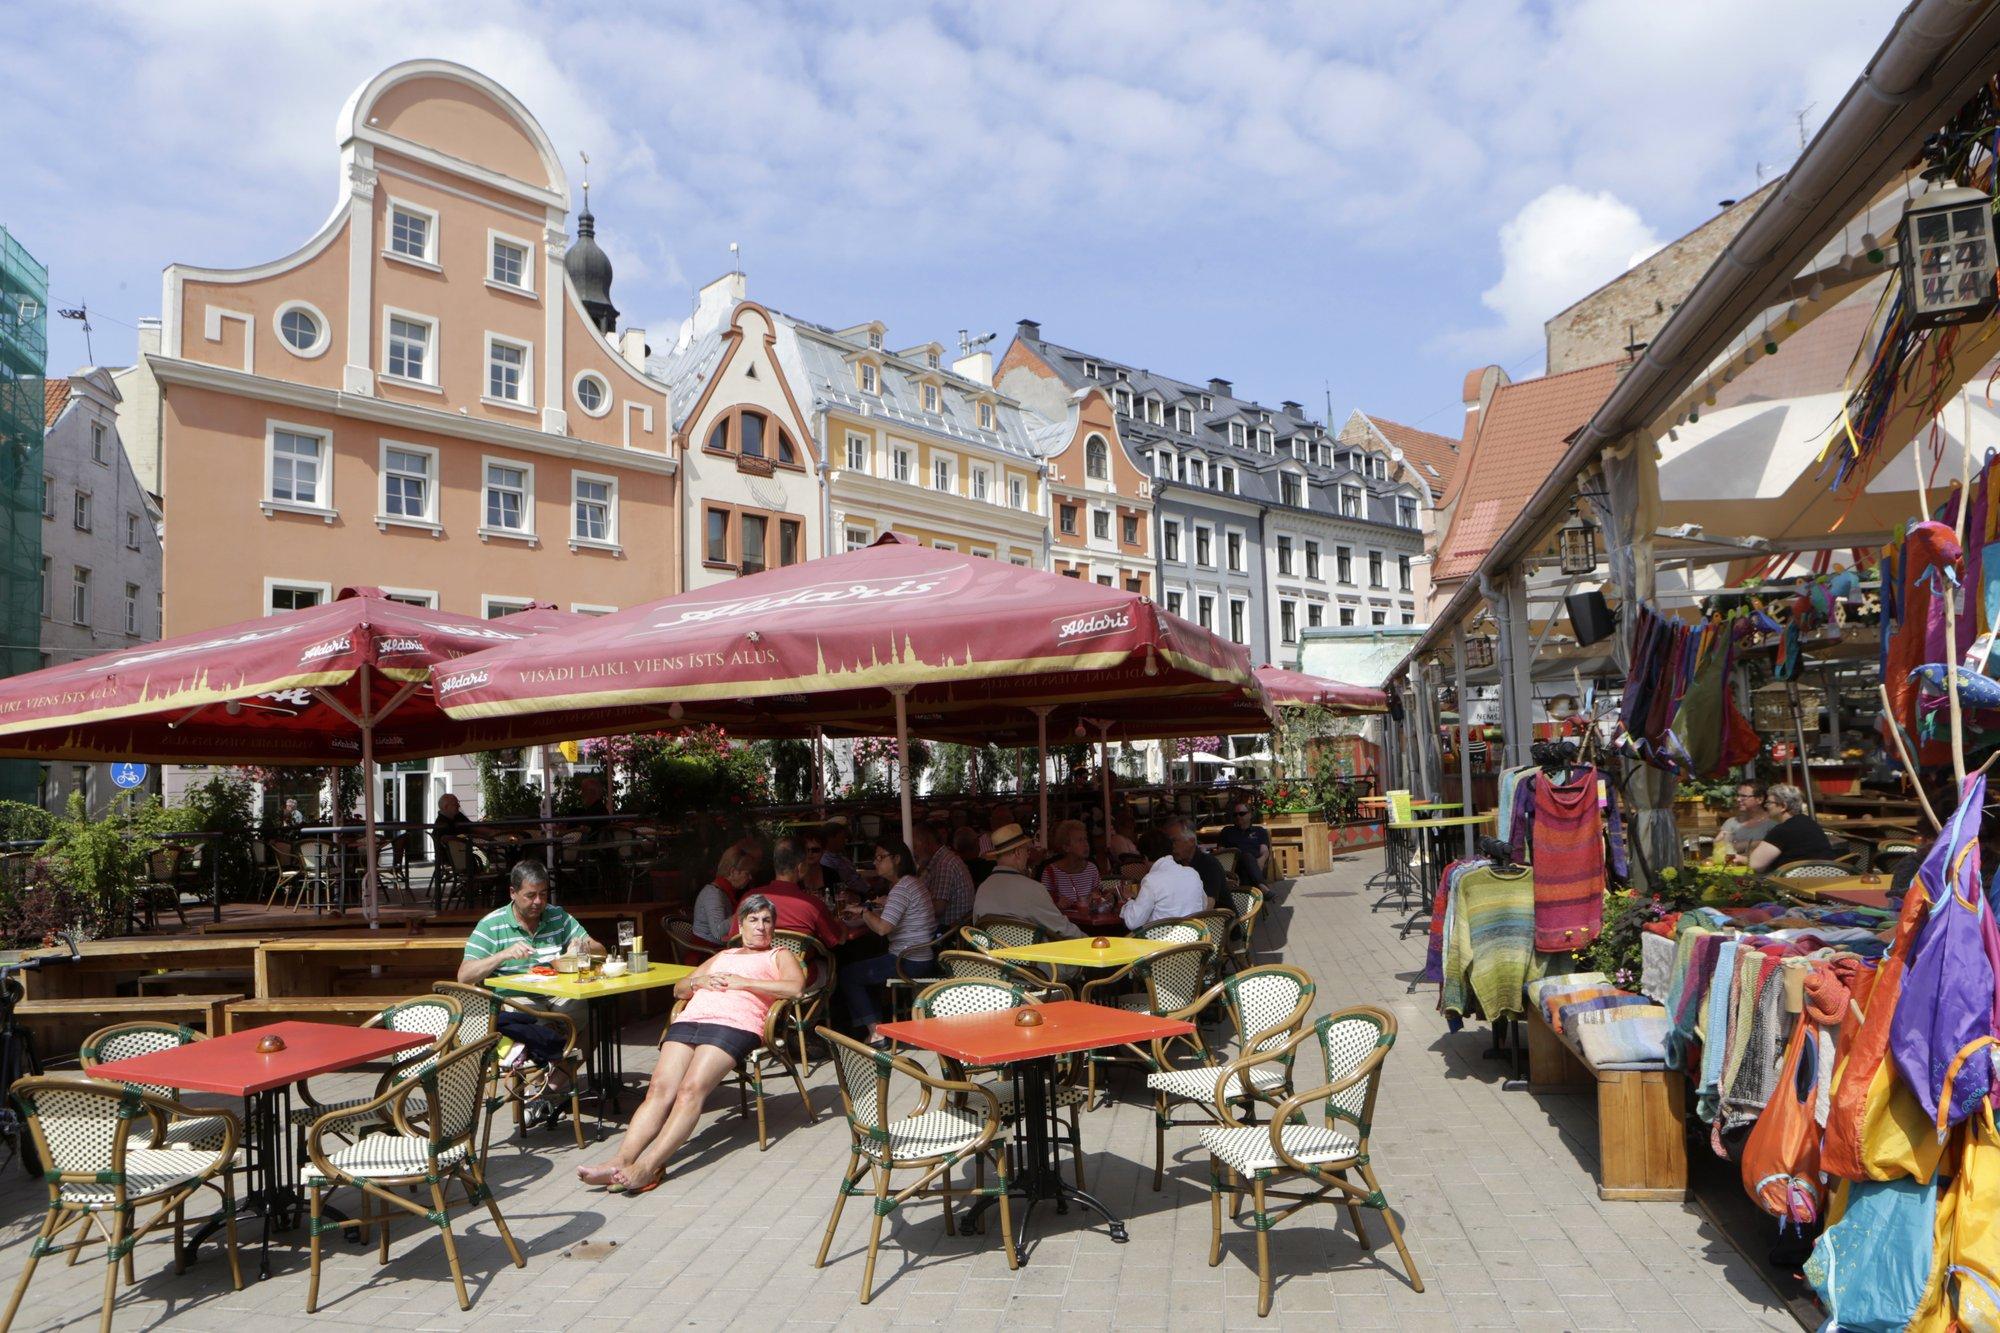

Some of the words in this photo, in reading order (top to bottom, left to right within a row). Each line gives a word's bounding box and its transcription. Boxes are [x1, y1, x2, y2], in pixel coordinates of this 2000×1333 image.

[653, 577, 946, 628] Aldaris
[1059, 612, 1129, 638] Aldaris
[301, 632, 350, 661] Aldaris
[380, 637, 425, 652] Aldaris
[520, 666, 574, 683] VISĀDI
[580, 661, 628, 679] LAIKI.
[634, 656, 685, 672] VIENS
[690, 652, 725, 668] ĪSTS
[731, 649, 779, 665] ALUS.
[440, 670, 489, 693] Aldaris
[26, 695, 60, 709] VIENS
